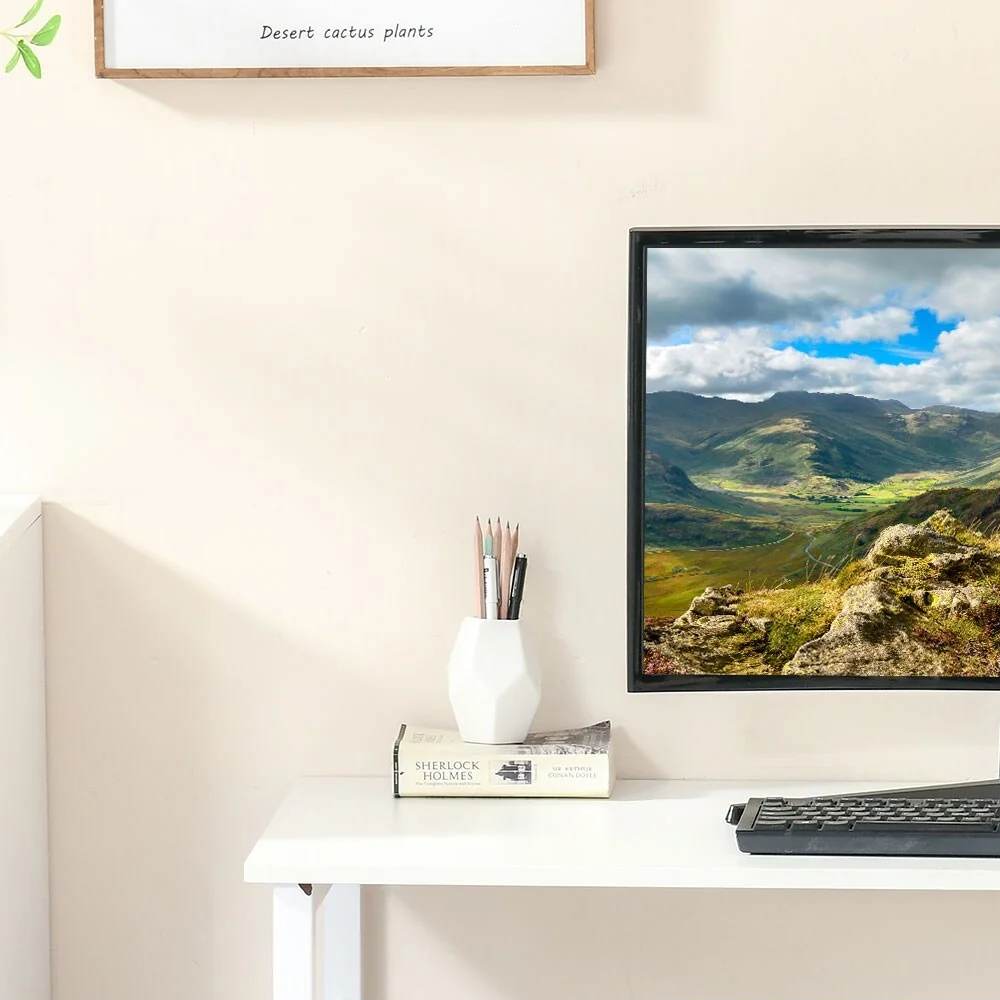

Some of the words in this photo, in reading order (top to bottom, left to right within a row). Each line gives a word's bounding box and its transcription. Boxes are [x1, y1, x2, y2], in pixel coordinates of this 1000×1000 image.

[260, 25, 315, 40] Desert
[324, 25, 375, 39] cactus
[383, 23, 434, 42] plants
[415, 761, 480, 771] SHERLOCK
[423, 771, 473, 781] HOLMES
